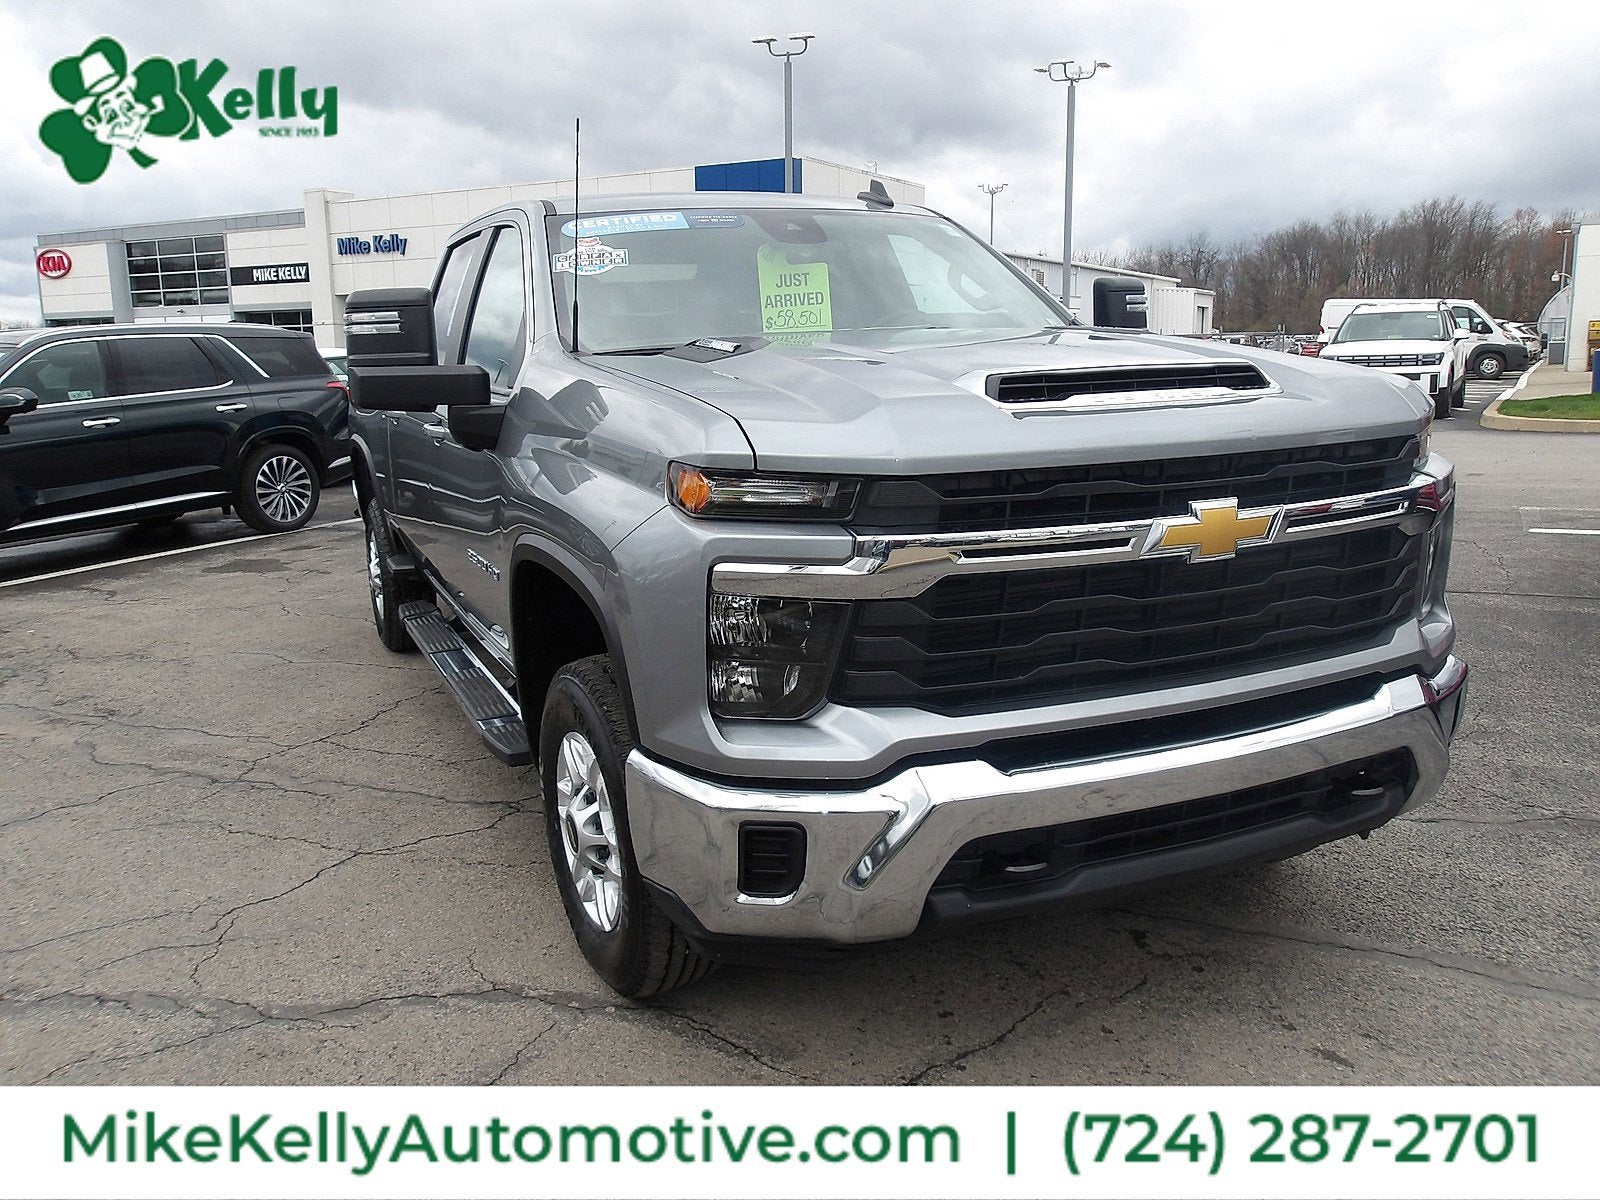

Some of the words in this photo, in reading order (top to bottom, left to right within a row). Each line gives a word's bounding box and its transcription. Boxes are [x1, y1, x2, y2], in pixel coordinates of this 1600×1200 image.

[568, 213, 678, 230] CERTIFIED
[337, 237, 371, 256] Mike
[372, 234, 408, 256] Kelly
[252, 267, 278, 282] MIKE
[278, 265, 307, 281] KELLY
[775, 272, 810, 288] JUST
[764, 291, 824, 309] ARRIVED
